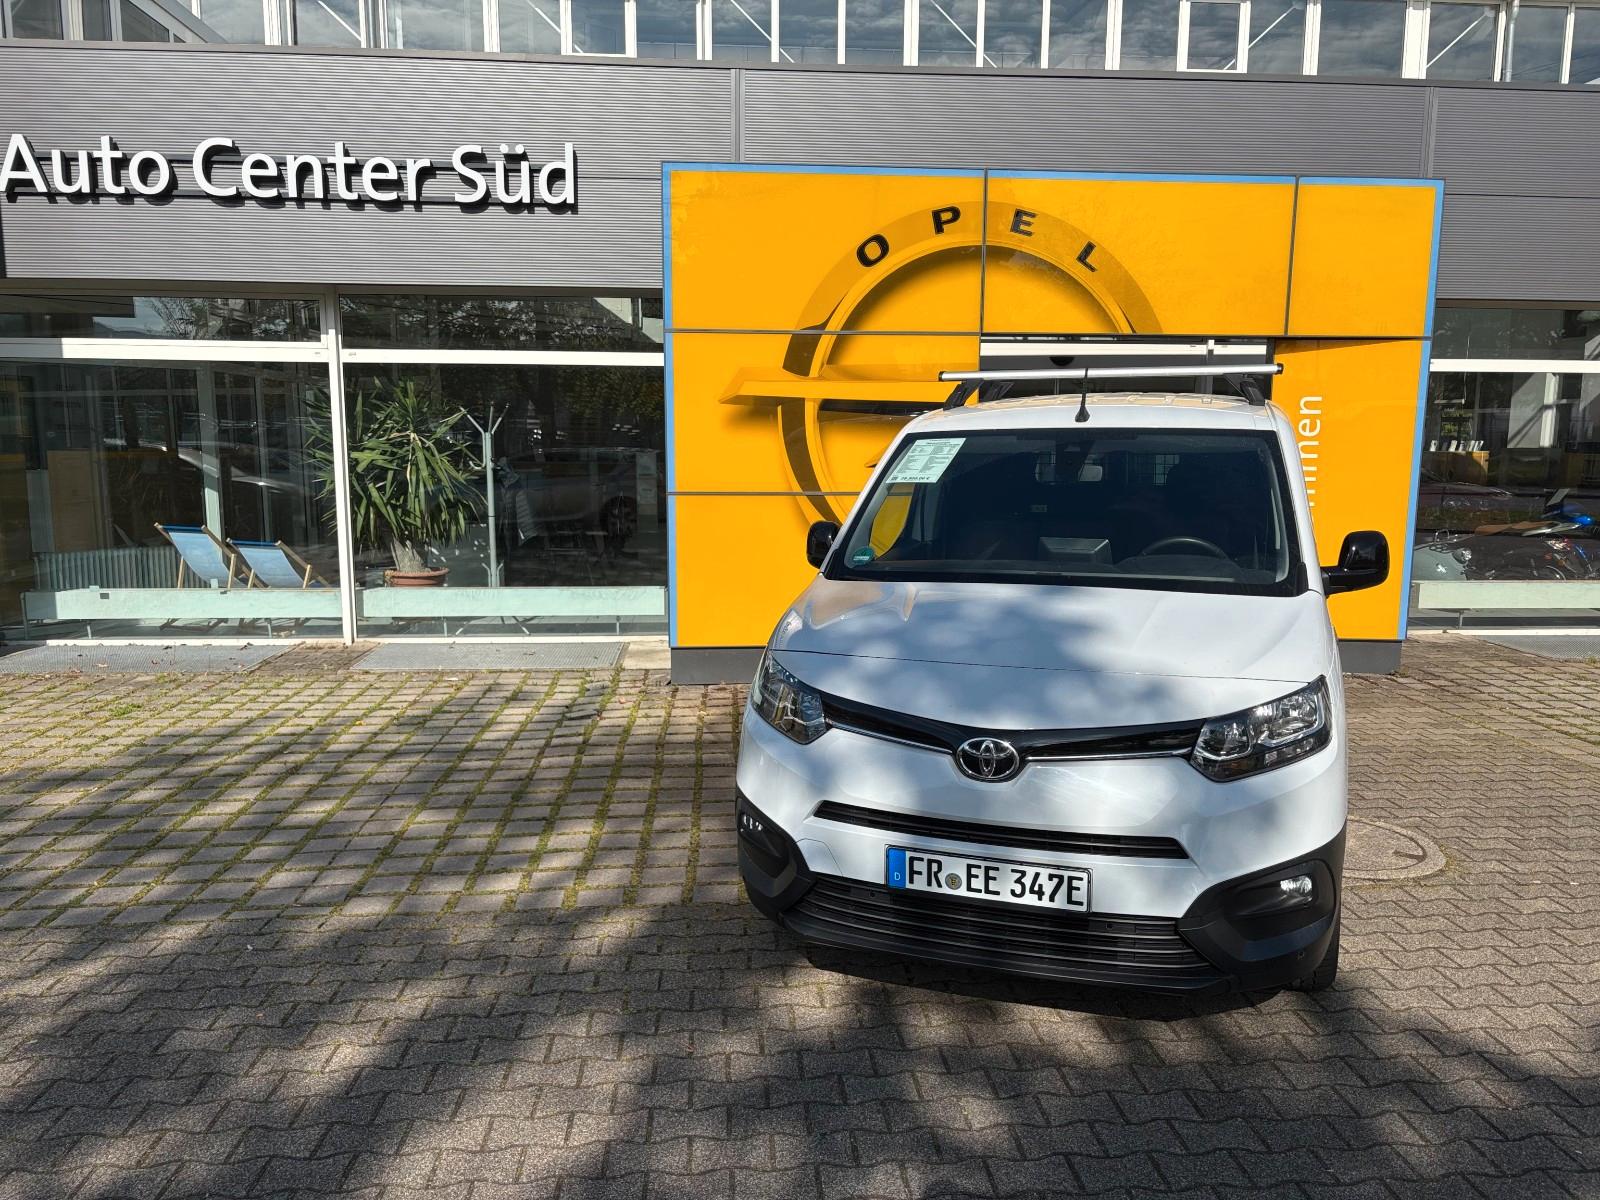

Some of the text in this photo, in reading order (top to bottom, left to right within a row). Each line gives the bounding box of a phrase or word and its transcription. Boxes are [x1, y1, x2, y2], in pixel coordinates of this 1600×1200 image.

[0, 133, 575, 204] Auto Center Süd
[856, 205, 1098, 273] OPEL
[893, 855, 1085, 907] D FR EE 347E
